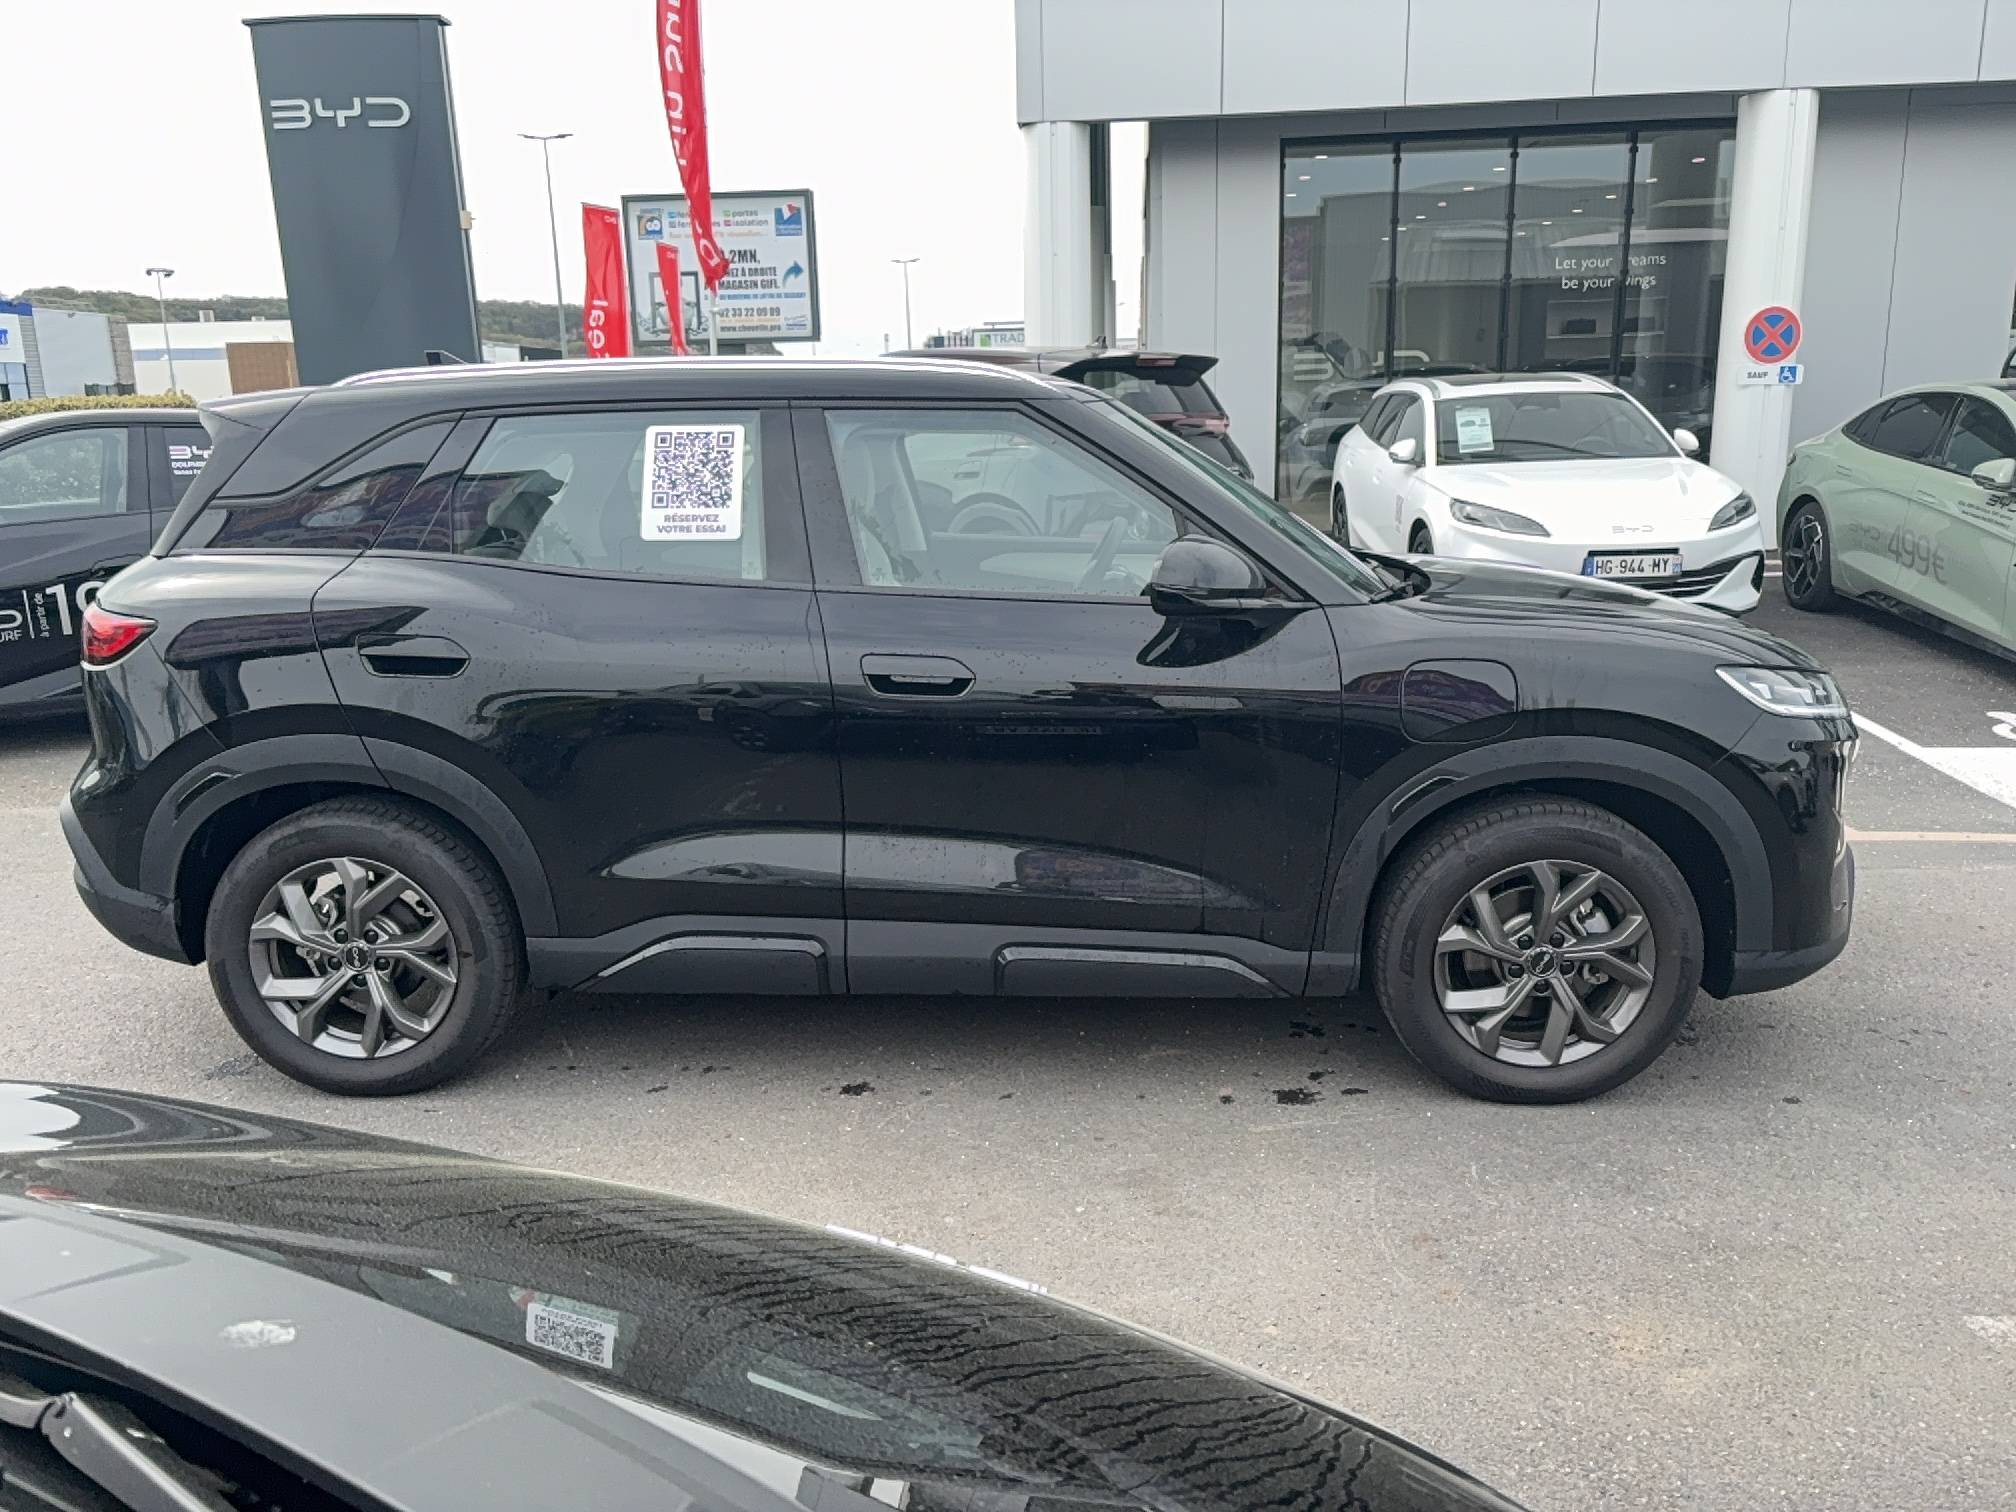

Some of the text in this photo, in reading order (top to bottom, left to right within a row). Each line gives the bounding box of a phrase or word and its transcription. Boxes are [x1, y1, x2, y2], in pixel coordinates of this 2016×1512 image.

[270, 97, 411, 129] BYD
[1555, 257, 1577, 270] Let
[1581, 257, 1613, 272] your
[748, 266, 777, 277] DROITE
[718, 279, 759, 289] MAGASIN
[1561, 276, 1580, 289] be
[1582, 277, 1616, 293] your
[731, 307, 743, 318] 33
[744, 307, 755, 318] 22
[1747, 371, 1769, 379] SAUF
[168, 445, 214, 459] BY
[663, 512, 720, 523] RÉSERVEZ
[656, 524, 727, 534] VOTRE ESSAI
[1887, 523, 1949, 586] 499€
[34, 592, 44, 605] de
